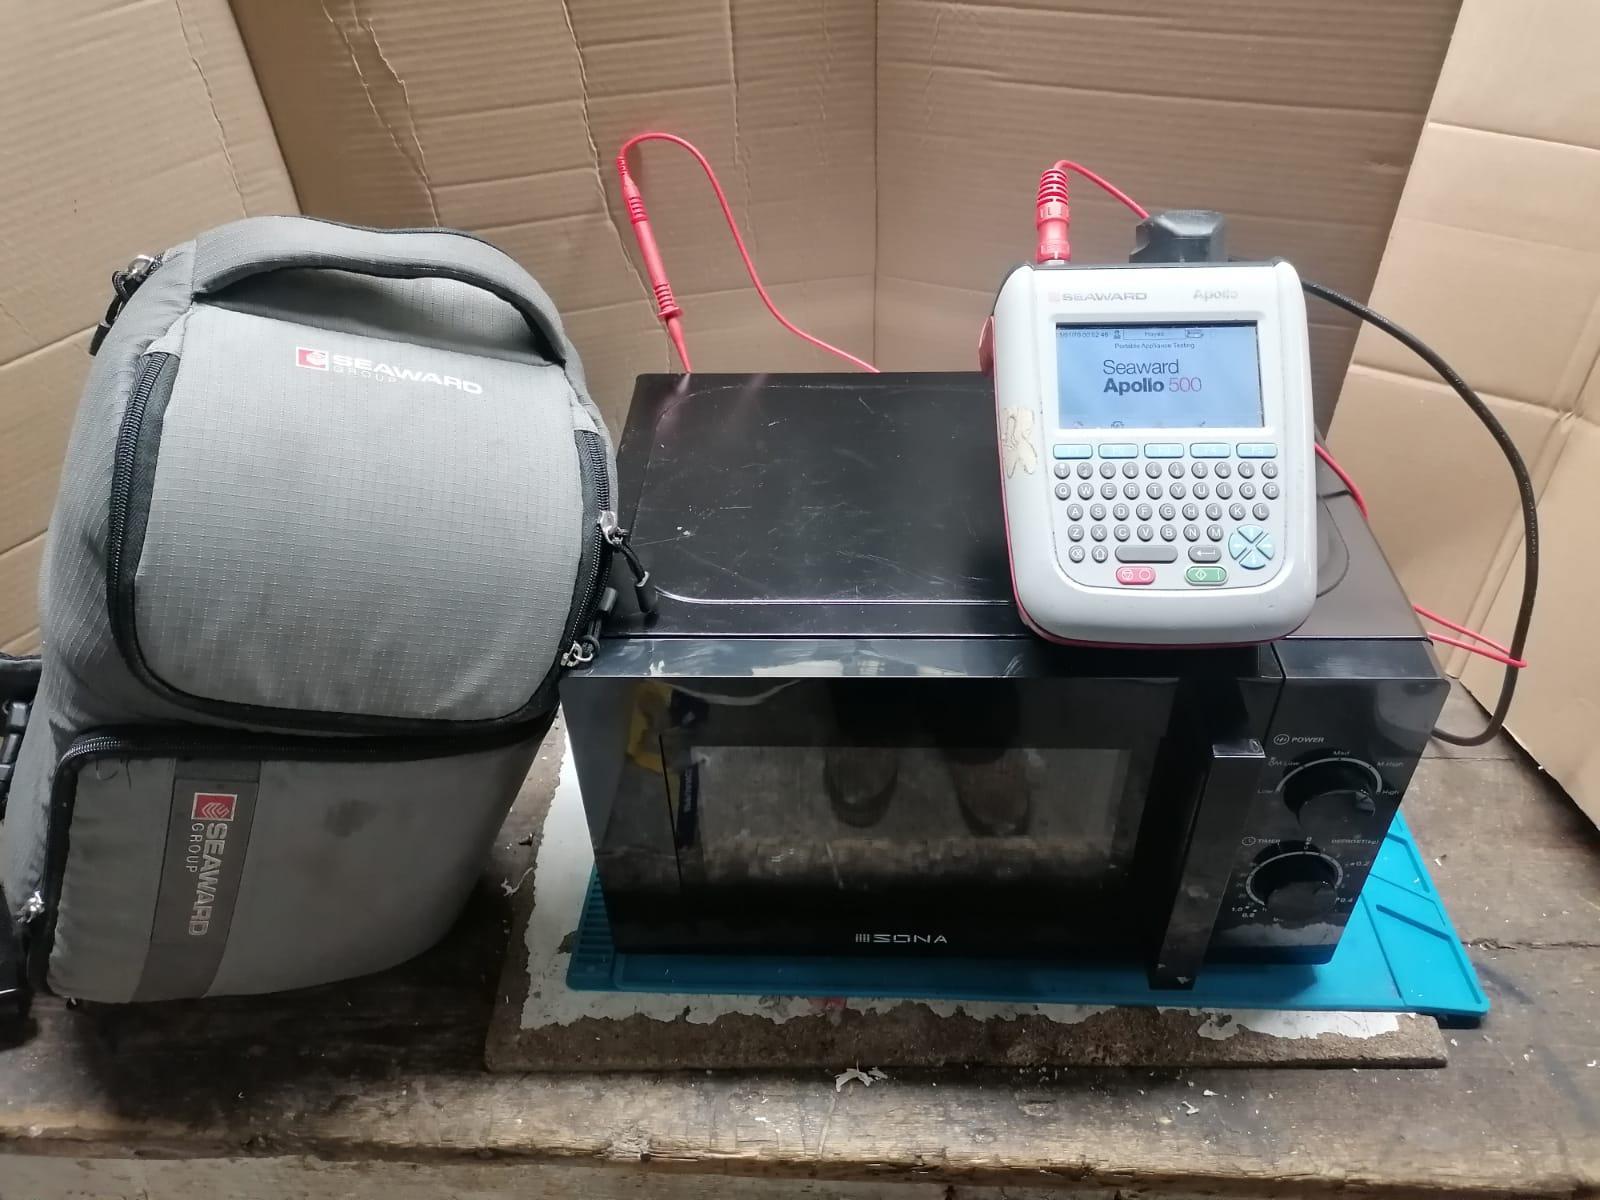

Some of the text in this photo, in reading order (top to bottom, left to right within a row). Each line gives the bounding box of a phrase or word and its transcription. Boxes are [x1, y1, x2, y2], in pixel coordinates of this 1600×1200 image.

[1062, 291, 1147, 302] SEAWARD
[333, 354, 483, 394] SEAWARD
[334, 365, 397, 382] GROUP
[1103, 359, 1179, 375] Seaward
[1103, 377, 1202, 396] Apollo 500
[1060, 486, 1067, 496] Q
[1081, 486, 1091, 495] W
[1105, 486, 1113, 495] E
[1128, 486, 1136, 495] R
[1152, 486, 1160, 496] T
[1174, 486, 1182, 494] Y
[1198, 485, 1206, 494] U
[1244, 486, 1253, 494] O
[1269, 485, 1276, 494] P
[1071, 507, 1264, 515] A S D F G H J K L
[1072, 528, 1221, 537] Z X C V B N M
[186, 822, 205, 873] GROUP
[188, 822, 228, 936] SEAWARD
[873, 933, 948, 944] SONA
